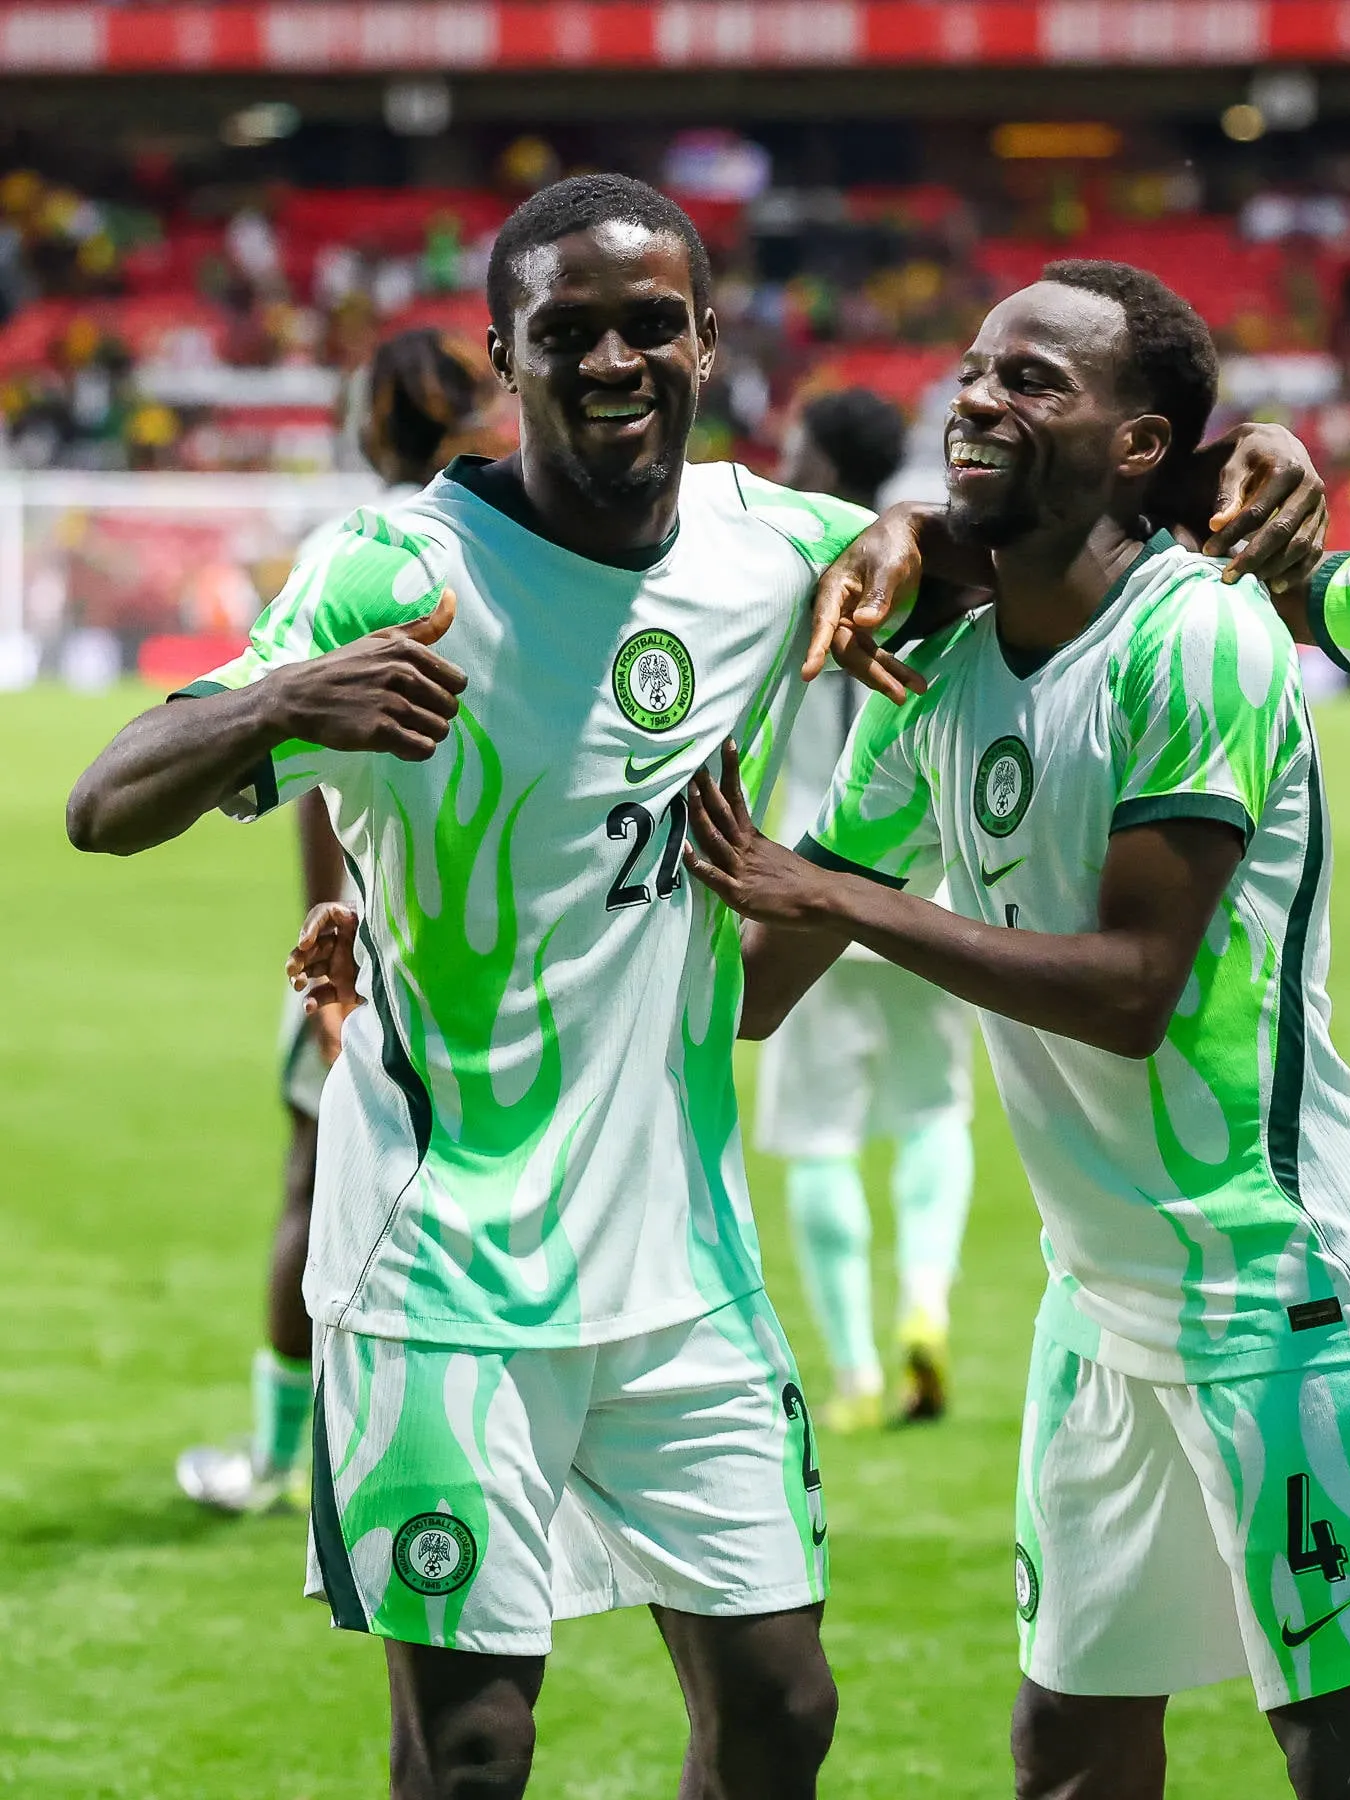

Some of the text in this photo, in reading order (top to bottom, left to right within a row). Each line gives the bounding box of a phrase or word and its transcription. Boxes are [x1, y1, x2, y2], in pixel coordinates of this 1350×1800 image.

[617, 634, 690, 717] NIGERIA FOOTBALL FEDERATION
[650, 714, 671, 727] 1945
[405, 1518, 452, 1537] FOOTBALL
[452, 1525, 471, 1582] FEDERATION
[1287, 1473, 1348, 1583] 4
